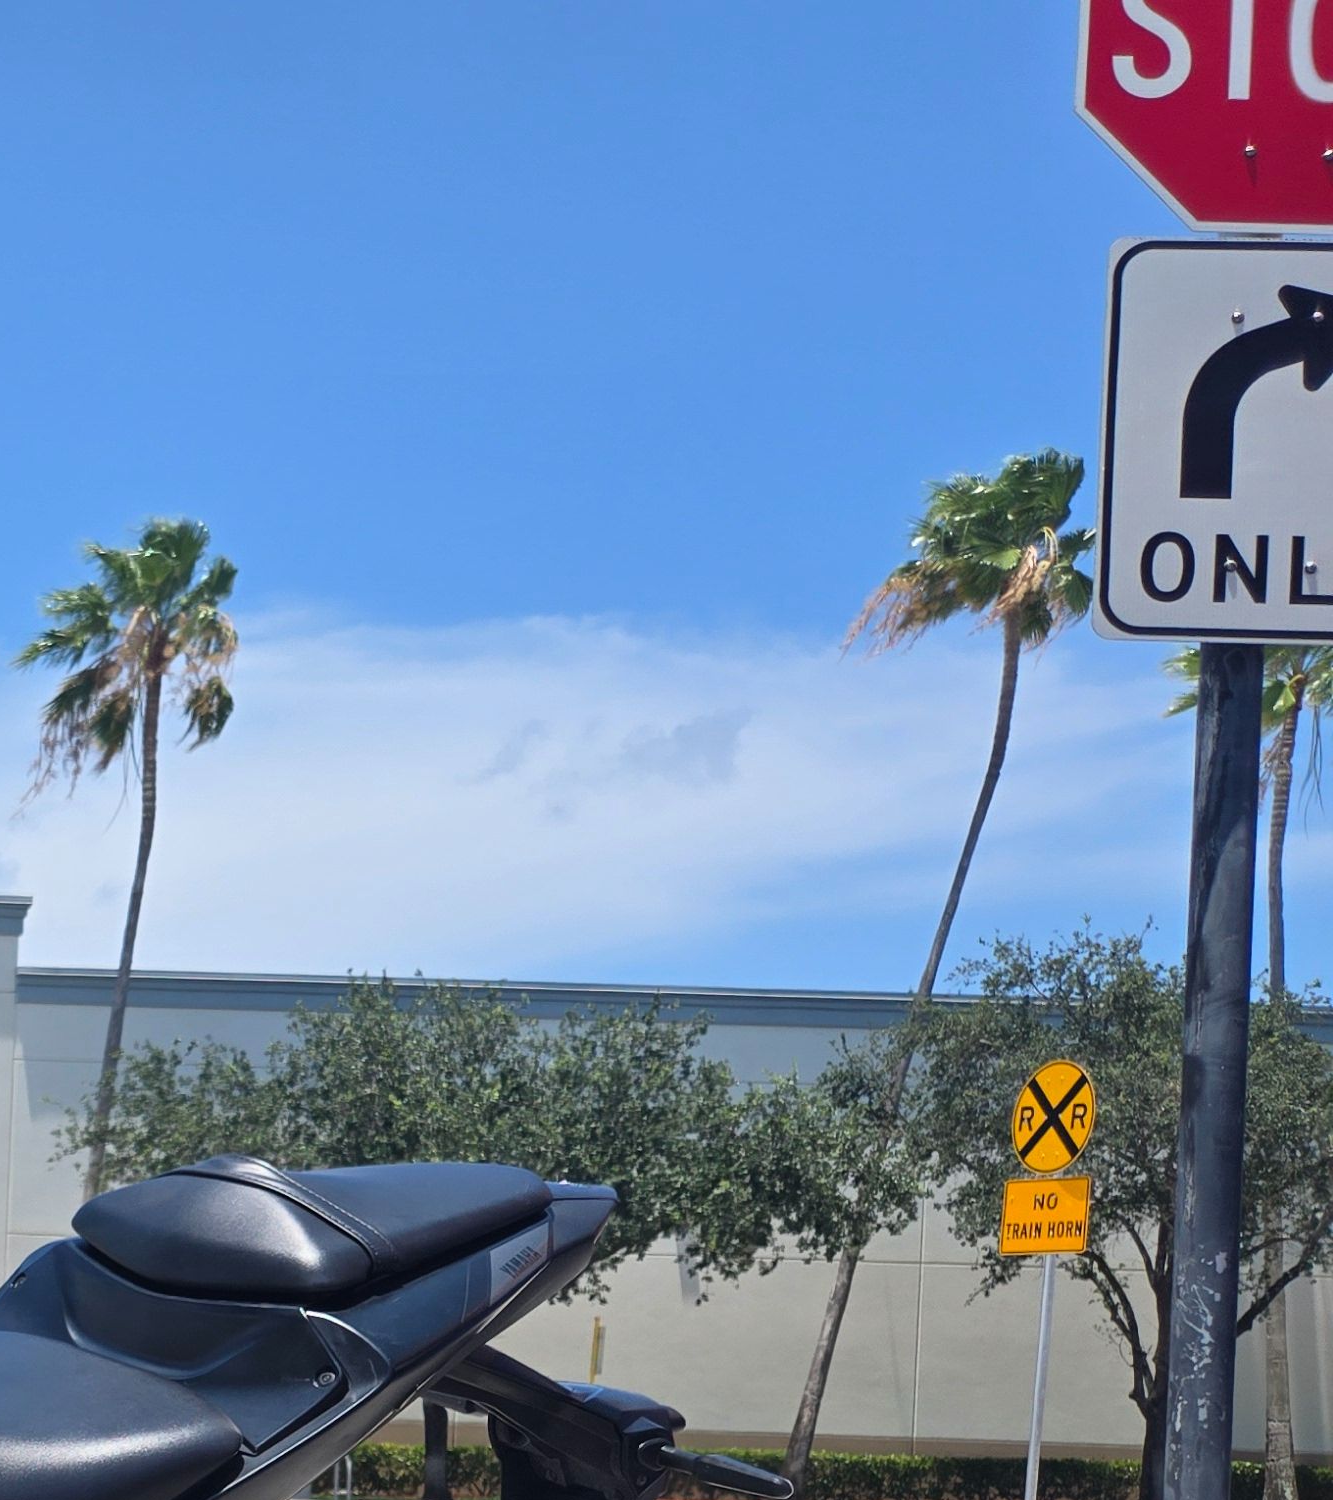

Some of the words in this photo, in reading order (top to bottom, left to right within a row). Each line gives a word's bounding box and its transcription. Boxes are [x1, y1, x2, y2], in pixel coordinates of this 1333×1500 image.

[1140, 531, 1333, 605] ONL
[1033, 1194, 1058, 1210] NO
[1006, 1222, 1042, 1240] TRAIN
[1048, 1221, 1083, 1237] HORN
[500, 1246, 542, 1279] YAMAHA
